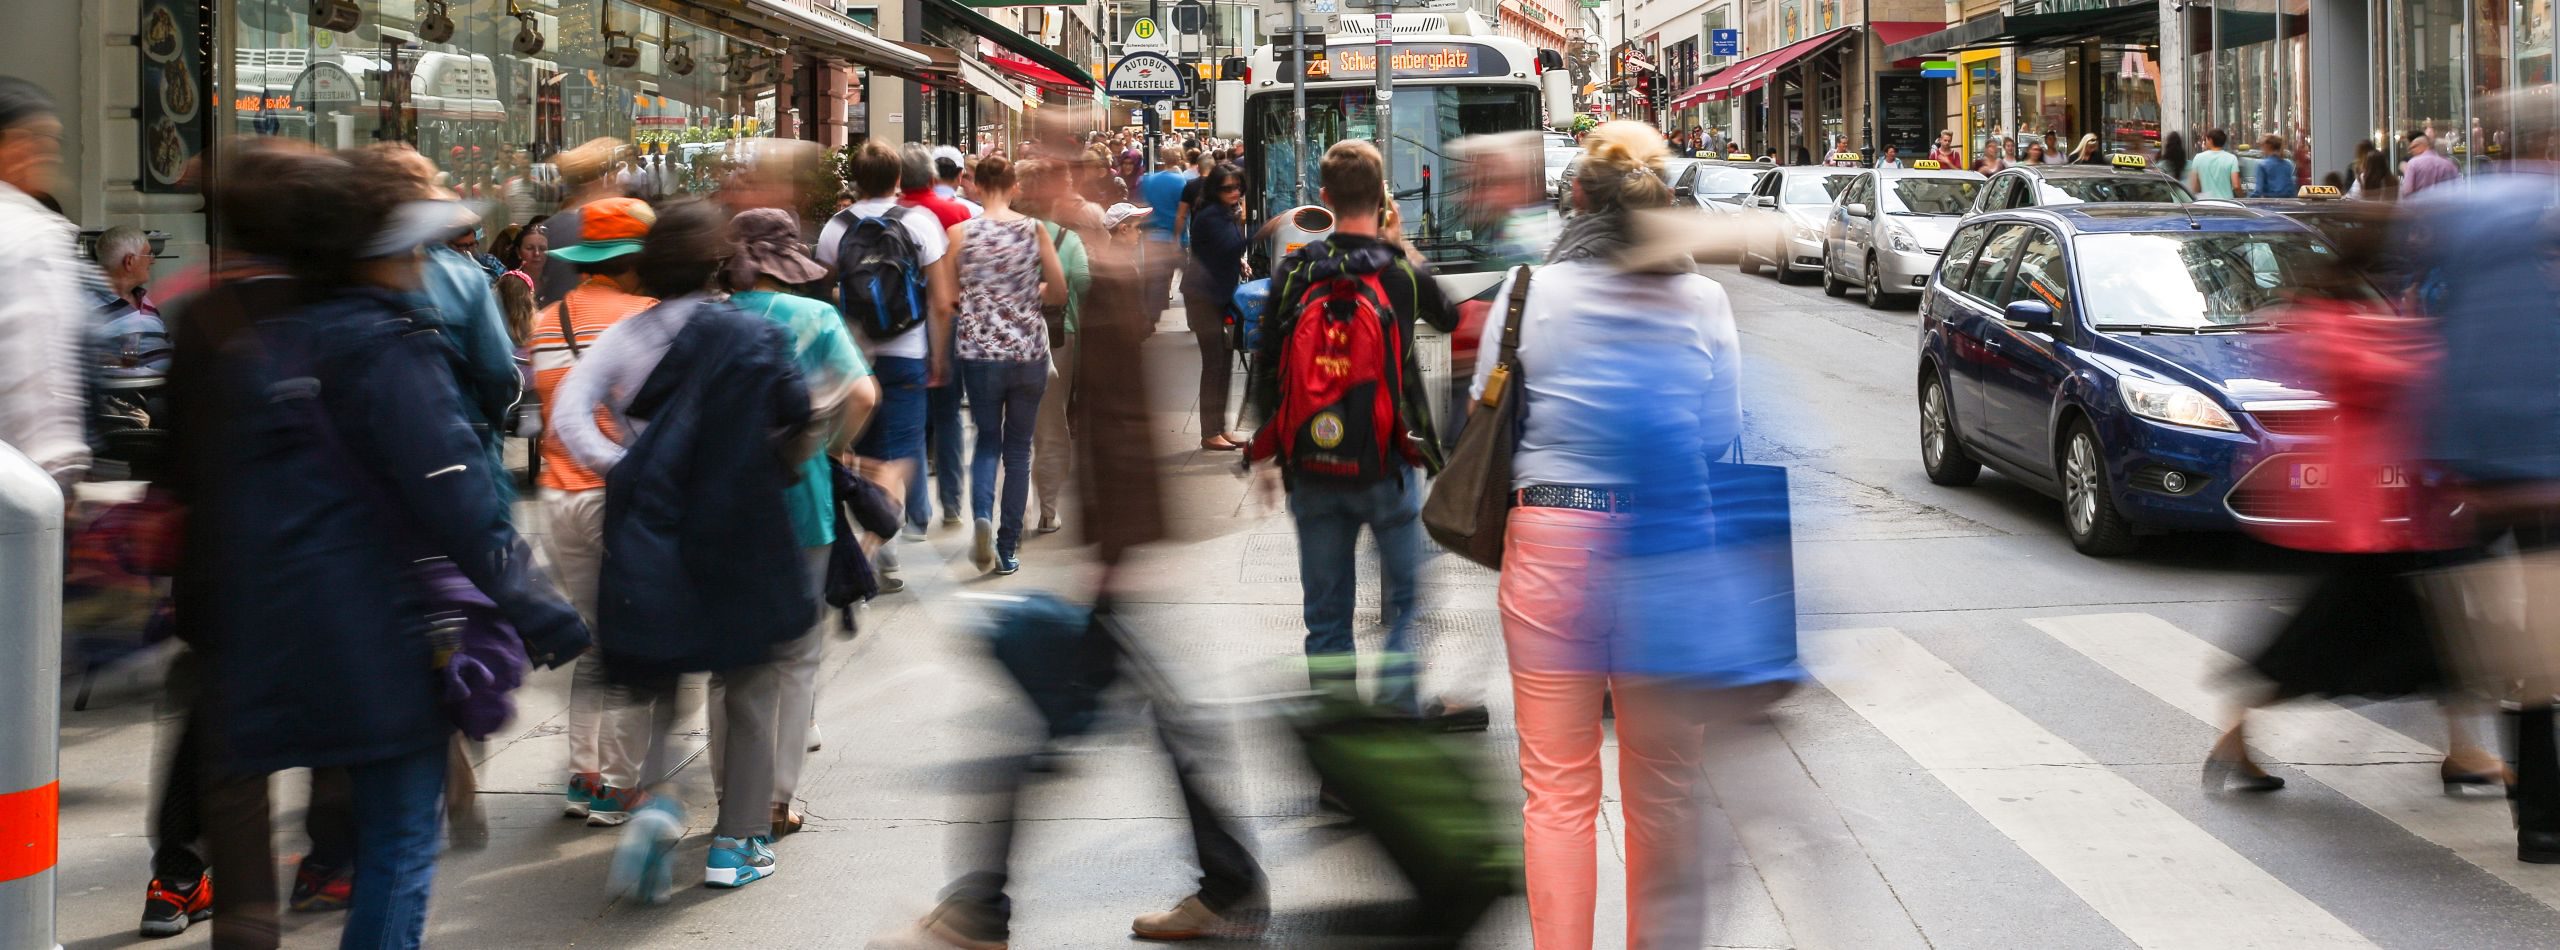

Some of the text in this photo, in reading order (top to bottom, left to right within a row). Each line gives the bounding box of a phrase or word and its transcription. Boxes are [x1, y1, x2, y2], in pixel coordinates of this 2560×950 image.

[1139, 22, 1150, 35] H
[1124, 58, 1167, 73] AUTOBUS
[1116, 80, 1175, 89] HALTESTELLE
[2117, 156, 2143, 166] TAXI
[2306, 186, 2337, 195] TAXI
